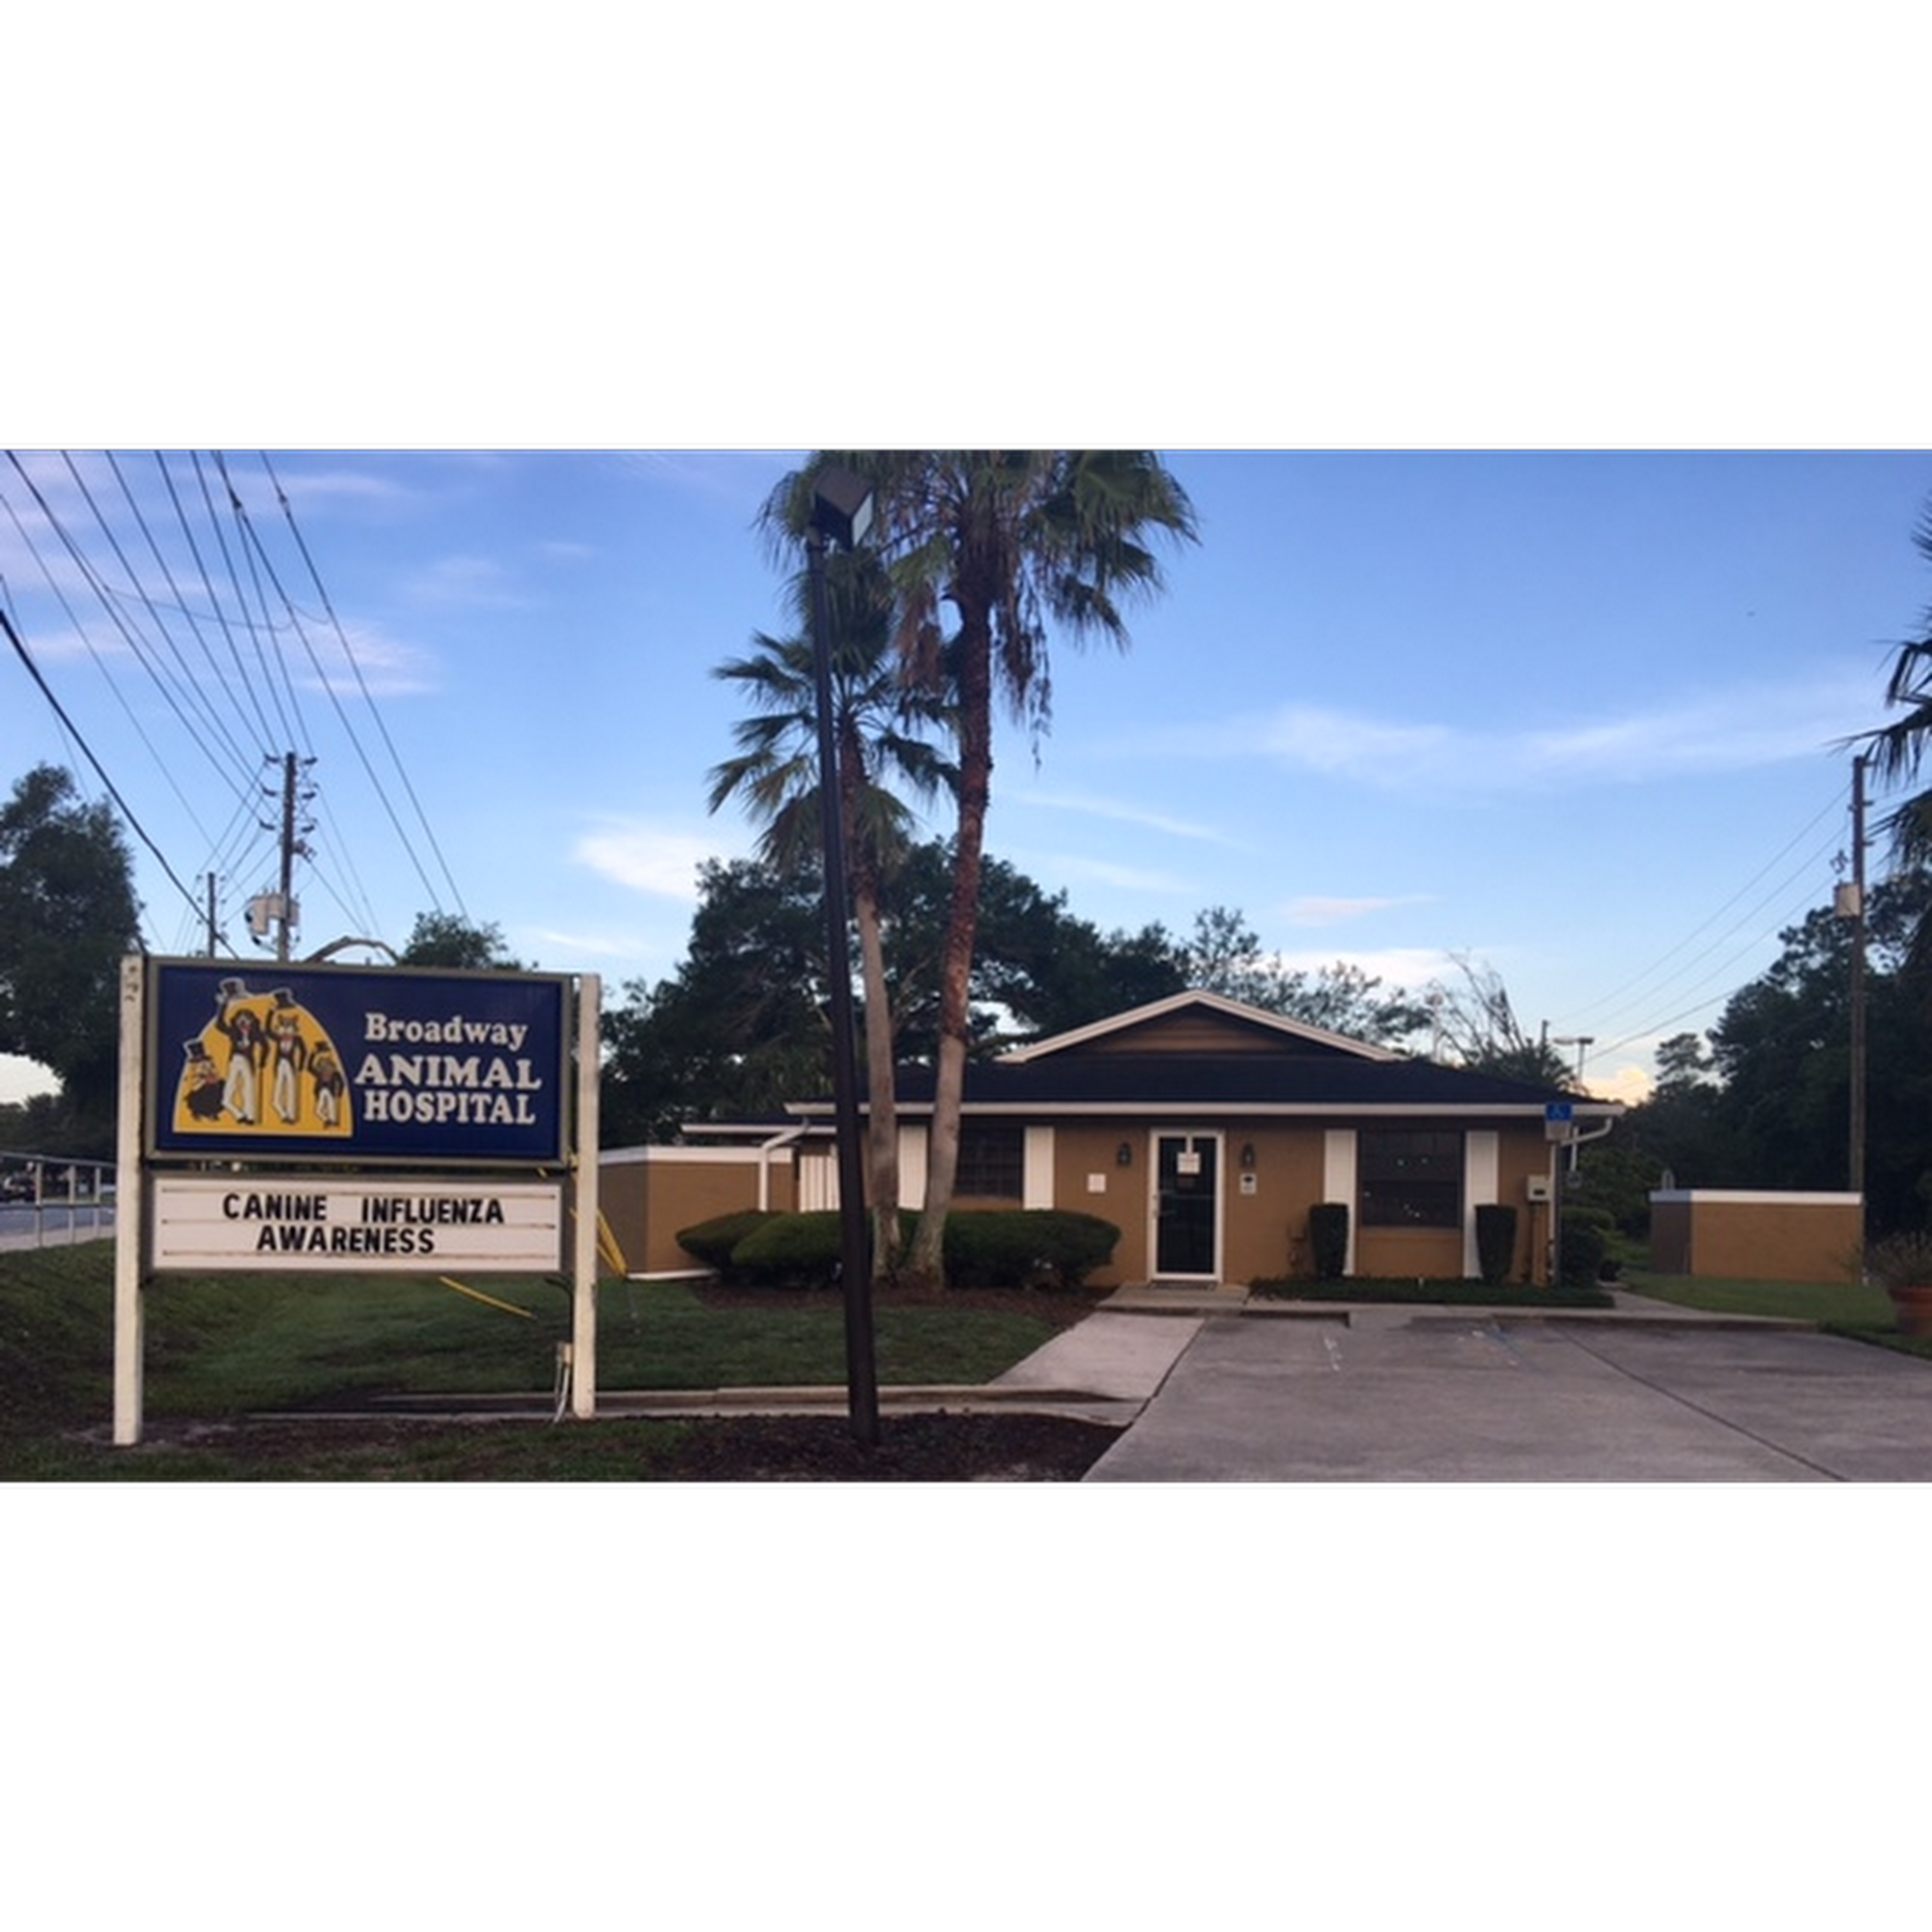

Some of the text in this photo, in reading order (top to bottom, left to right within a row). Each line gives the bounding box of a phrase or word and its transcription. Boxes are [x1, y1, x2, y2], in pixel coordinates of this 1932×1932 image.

[365, 1012, 528, 1051] Broadway
[355, 1054, 542, 1090] ANIMAL
[364, 1091, 536, 1124] HOSPITAL
[223, 1193, 505, 1224] CANINE INFLUENZA
[257, 1226, 435, 1254] AWARENESS
